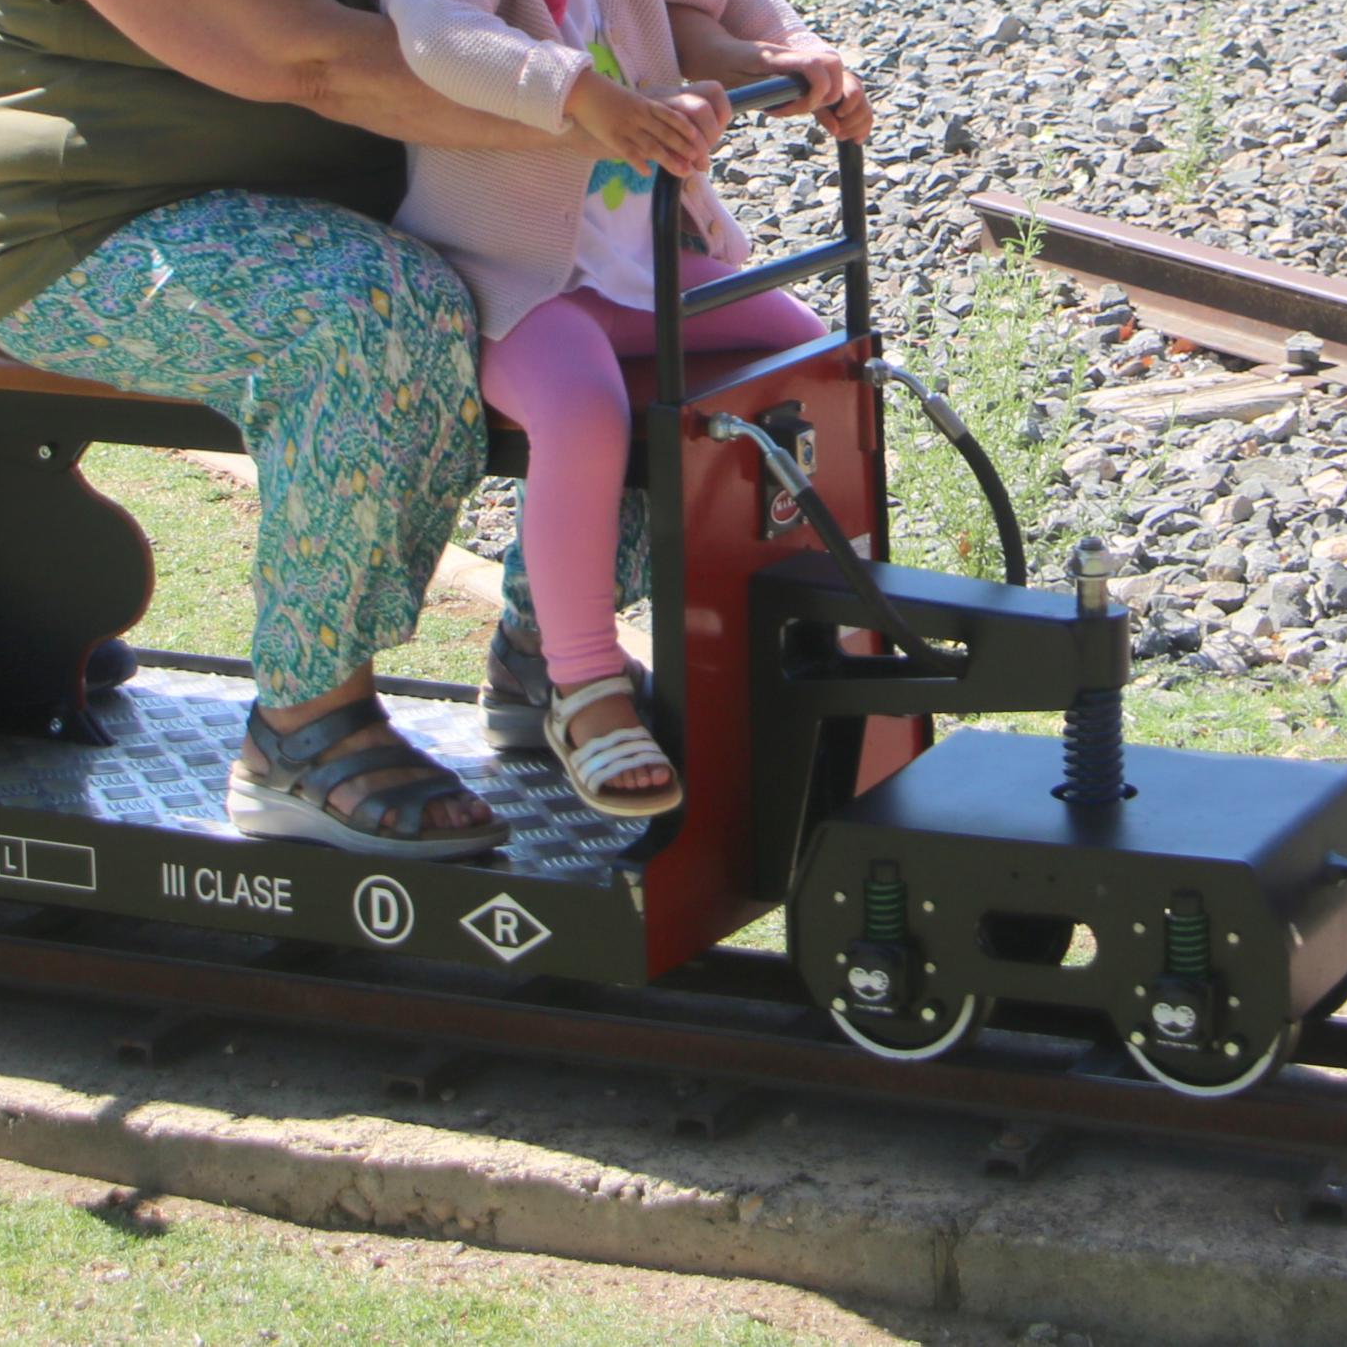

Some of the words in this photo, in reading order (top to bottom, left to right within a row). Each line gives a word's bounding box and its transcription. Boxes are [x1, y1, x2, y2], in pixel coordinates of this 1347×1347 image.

[4, 845, 18, 871] L
[161, 862, 186, 898] III
[194, 867, 294, 913] CLASE
[370, 886, 399, 932] D
[494, 909, 519, 944] R
